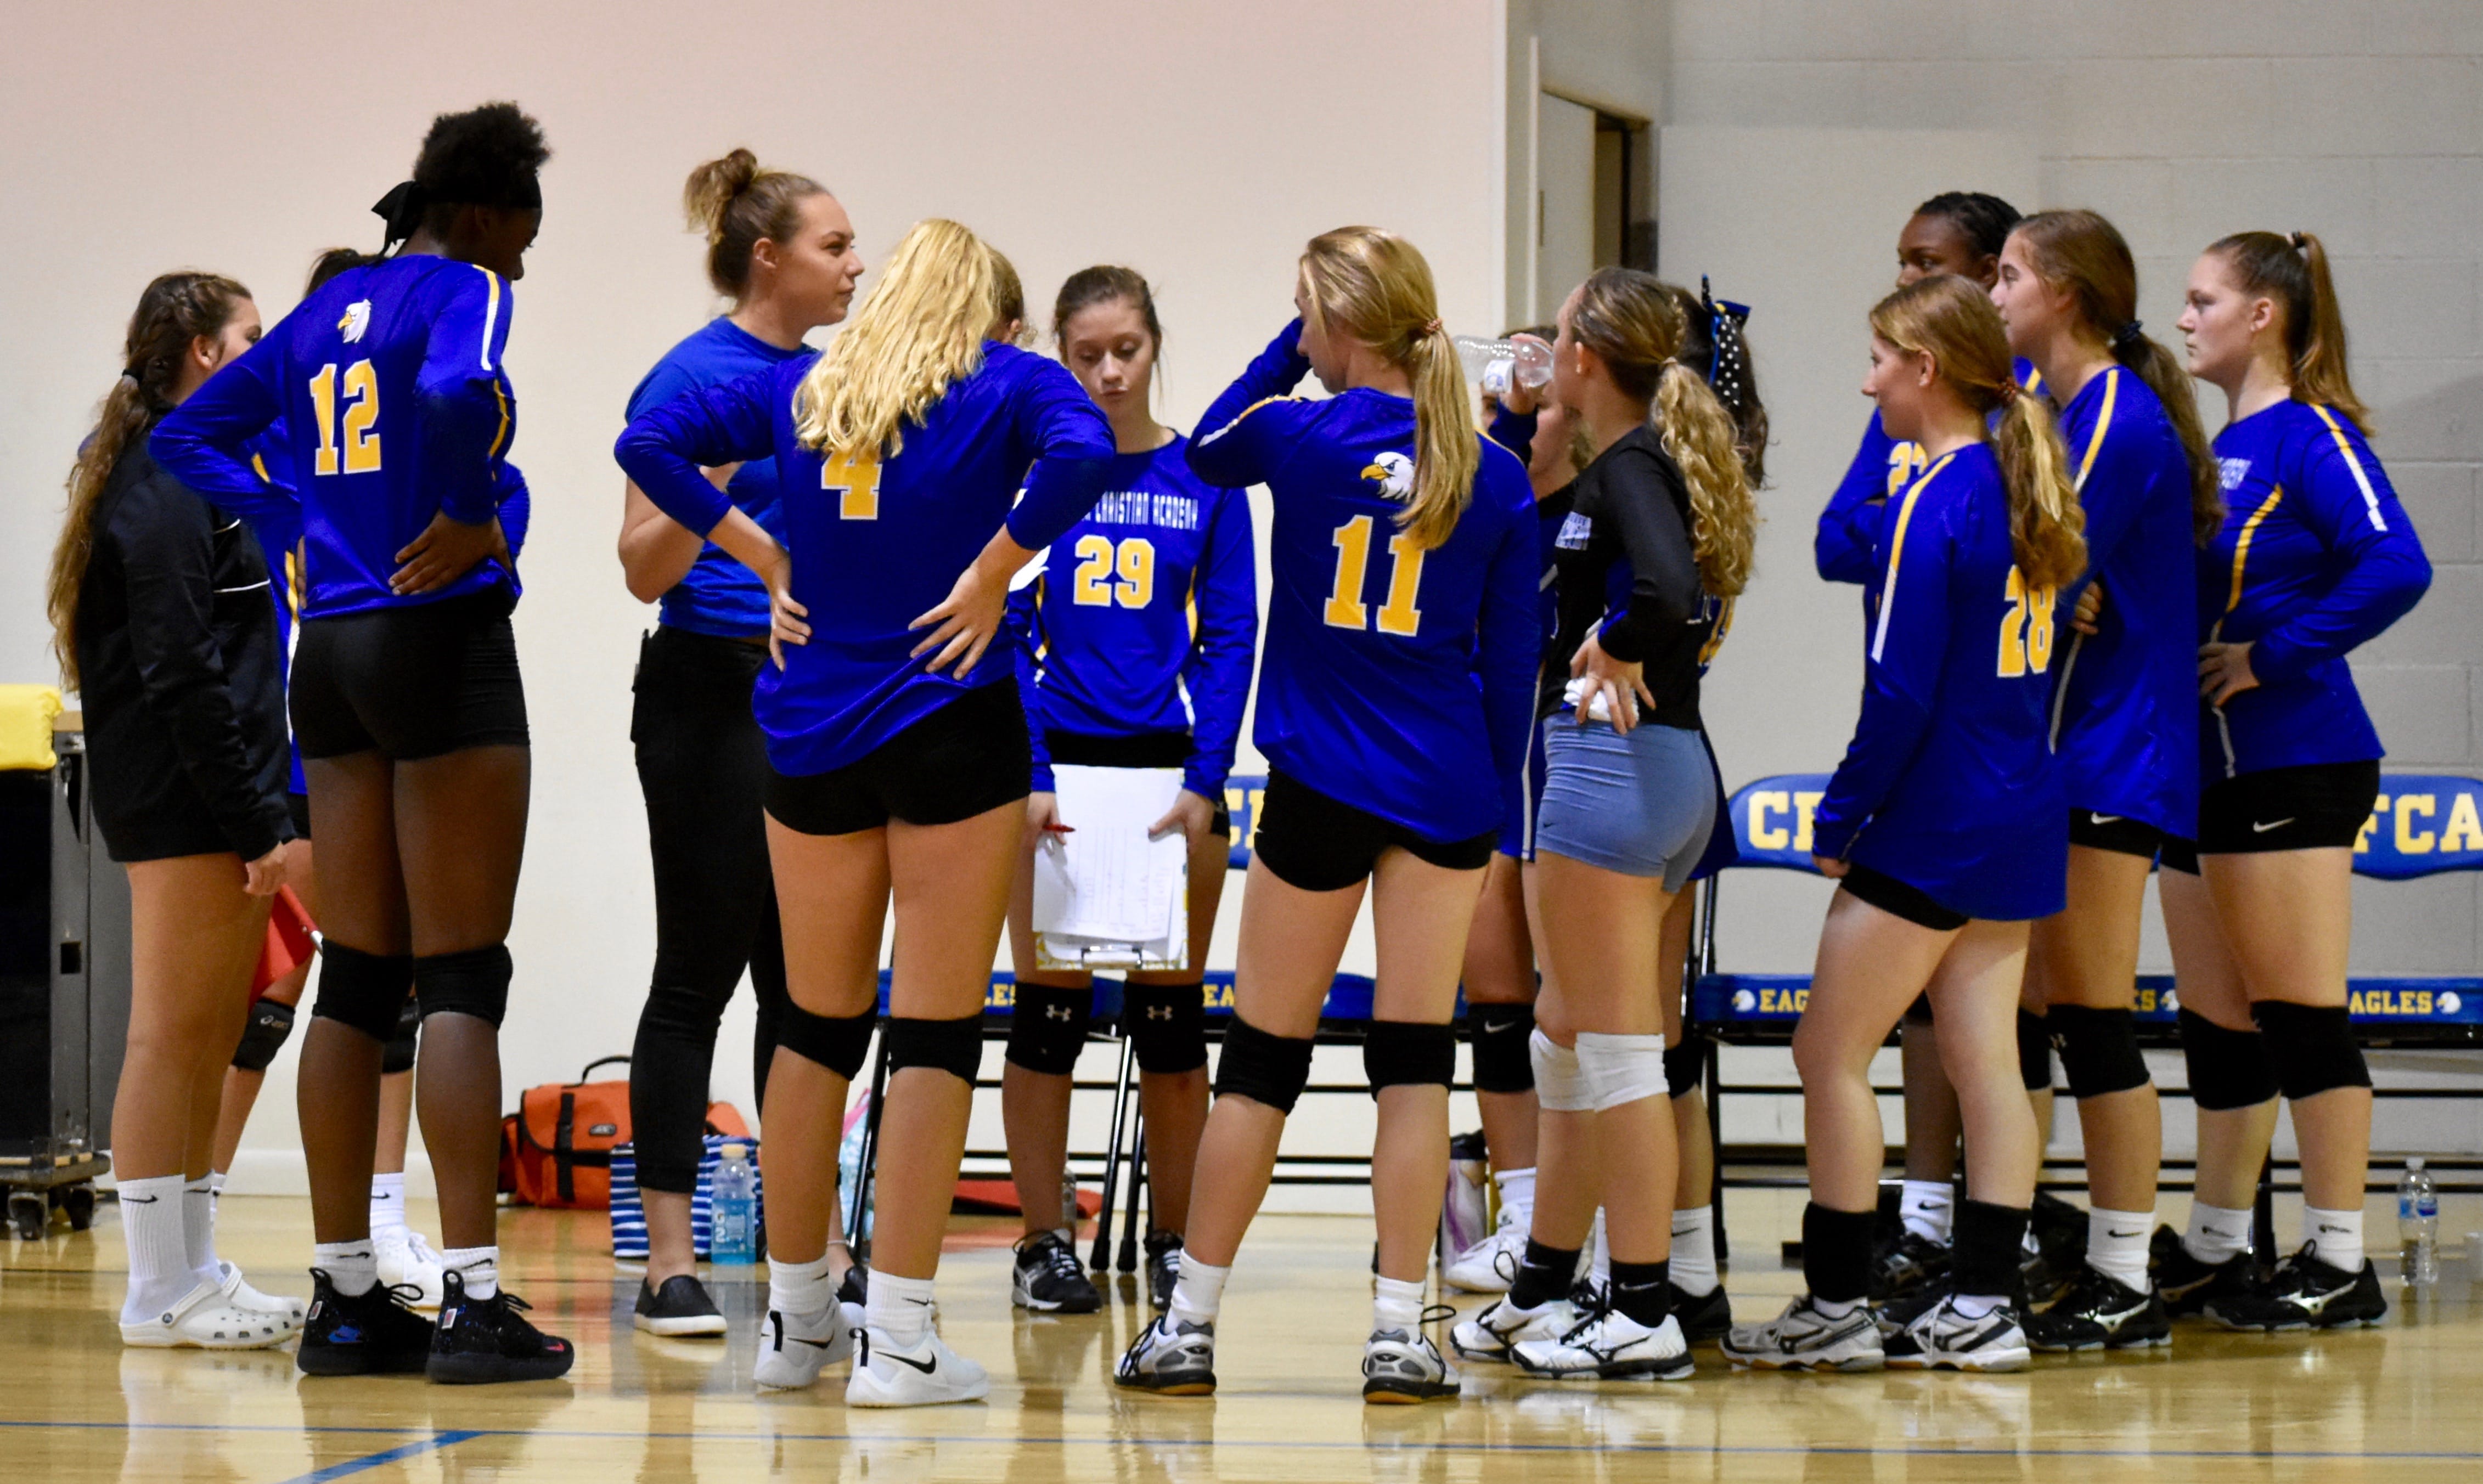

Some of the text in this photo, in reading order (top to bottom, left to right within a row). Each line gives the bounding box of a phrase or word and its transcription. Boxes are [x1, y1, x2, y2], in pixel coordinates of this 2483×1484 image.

[309, 358, 381, 476] 12
[821, 447, 882, 520] 4
[1073, 534, 1155, 610] 29
[1323, 514, 1426, 637] 11
[1997, 564, 2057, 678] 28
